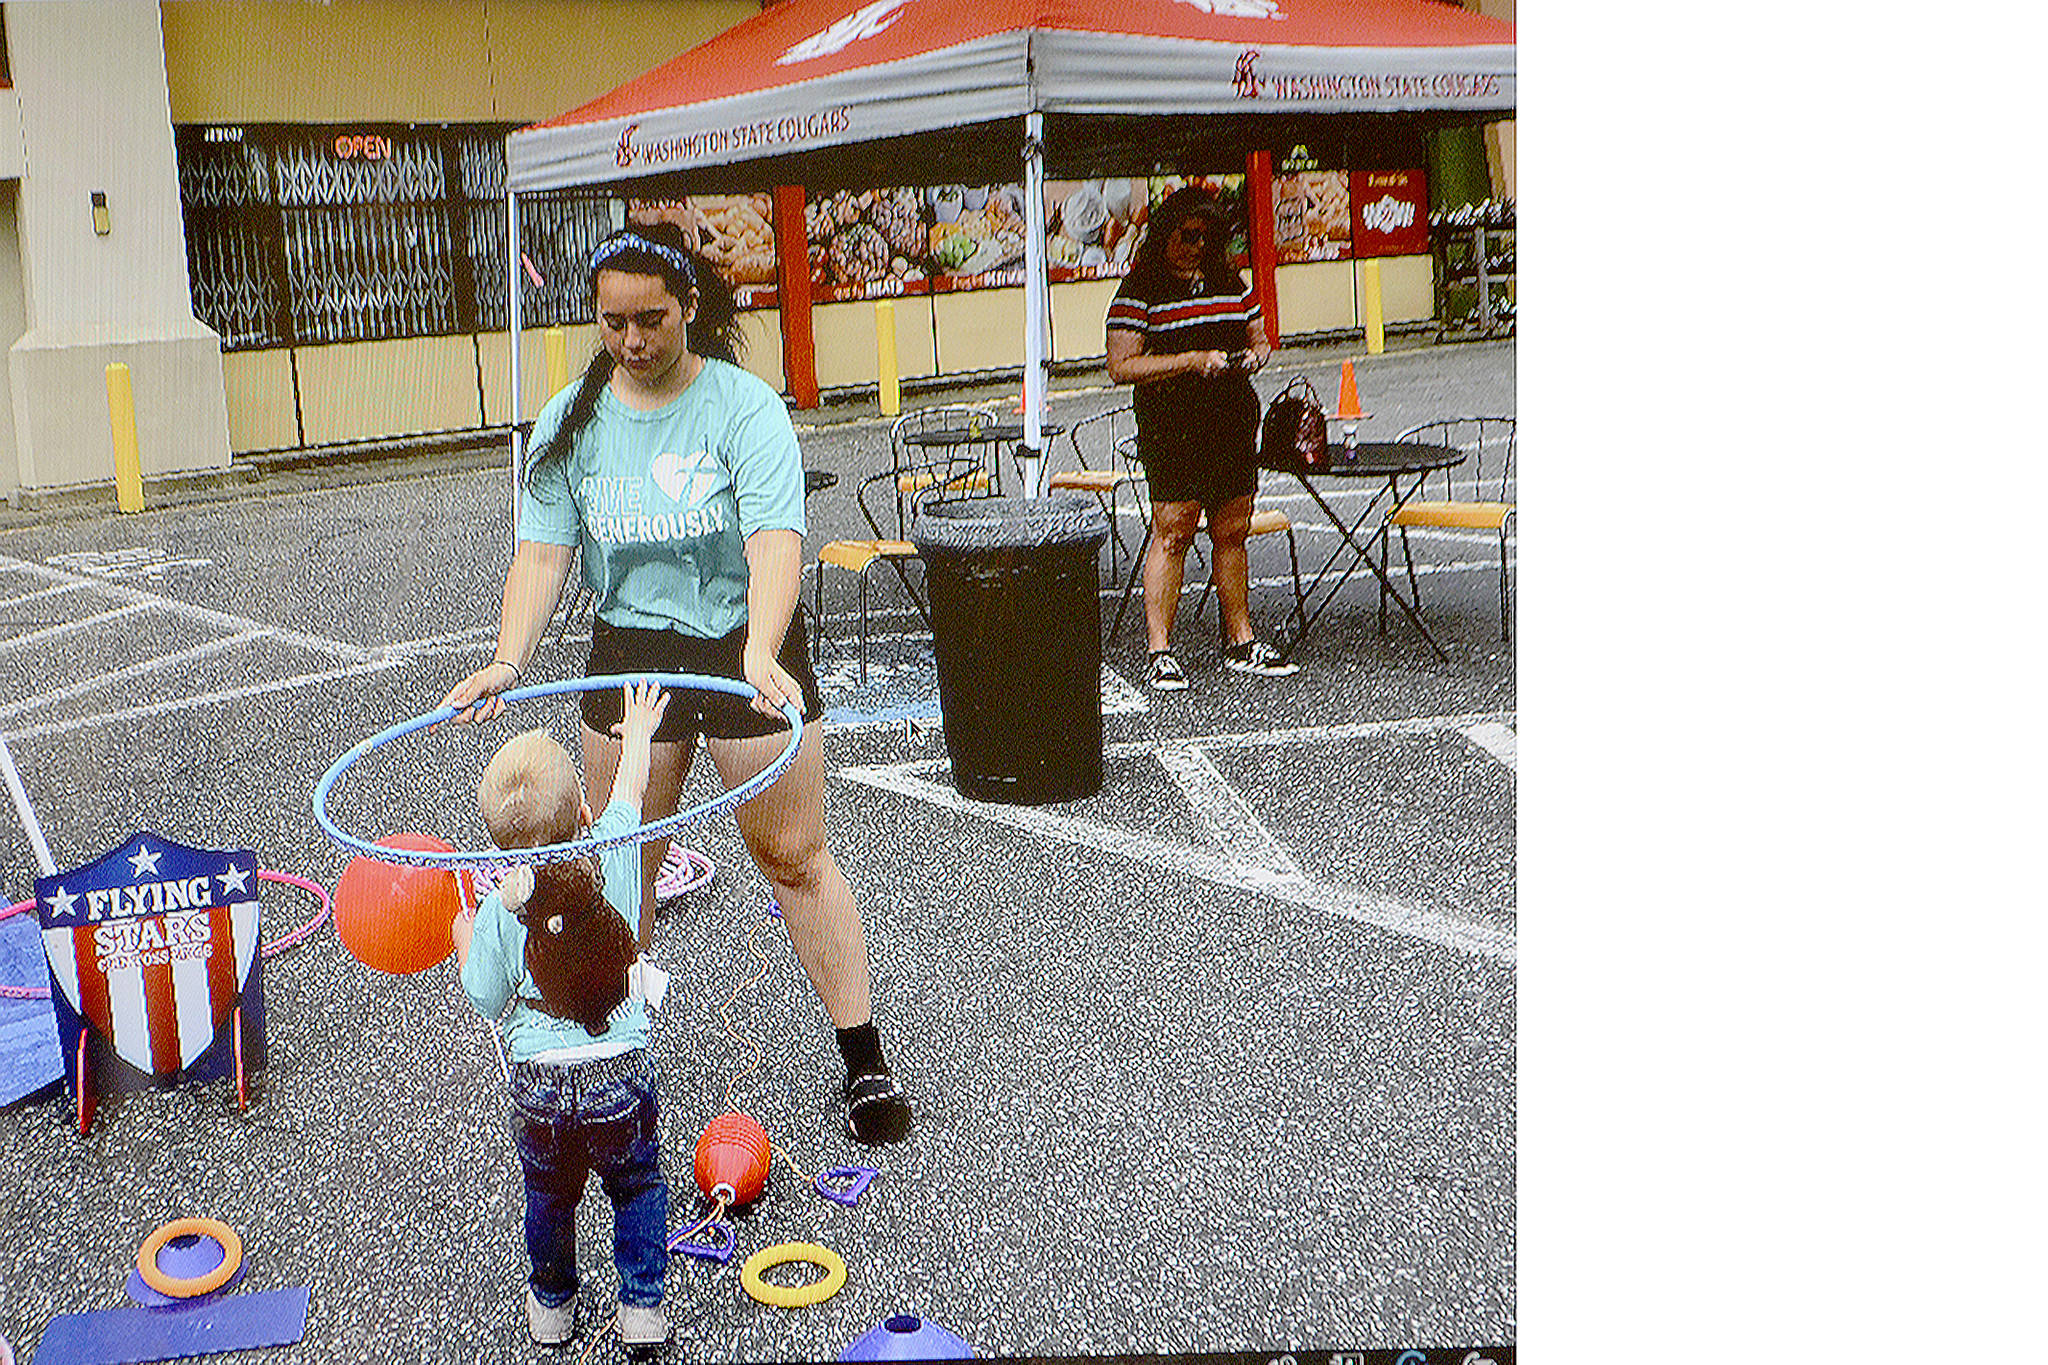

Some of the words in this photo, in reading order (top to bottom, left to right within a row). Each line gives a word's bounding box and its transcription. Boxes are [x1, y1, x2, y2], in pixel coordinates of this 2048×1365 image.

[1272, 74, 1381, 100] WASHINGTON
[1385, 74, 1428, 98] STATE
[1432, 73, 1501, 98] COUGARS
[334, 134, 393, 160] OPEN
[640, 128, 728, 166] WASHINGTON
[732, 119, 774, 149] STATE
[777, 105, 851, 142] COUGARS
[581, 475, 644, 516] GIVE
[85, 875, 213, 922] FLYING
[92, 907, 213, 958] STARS
